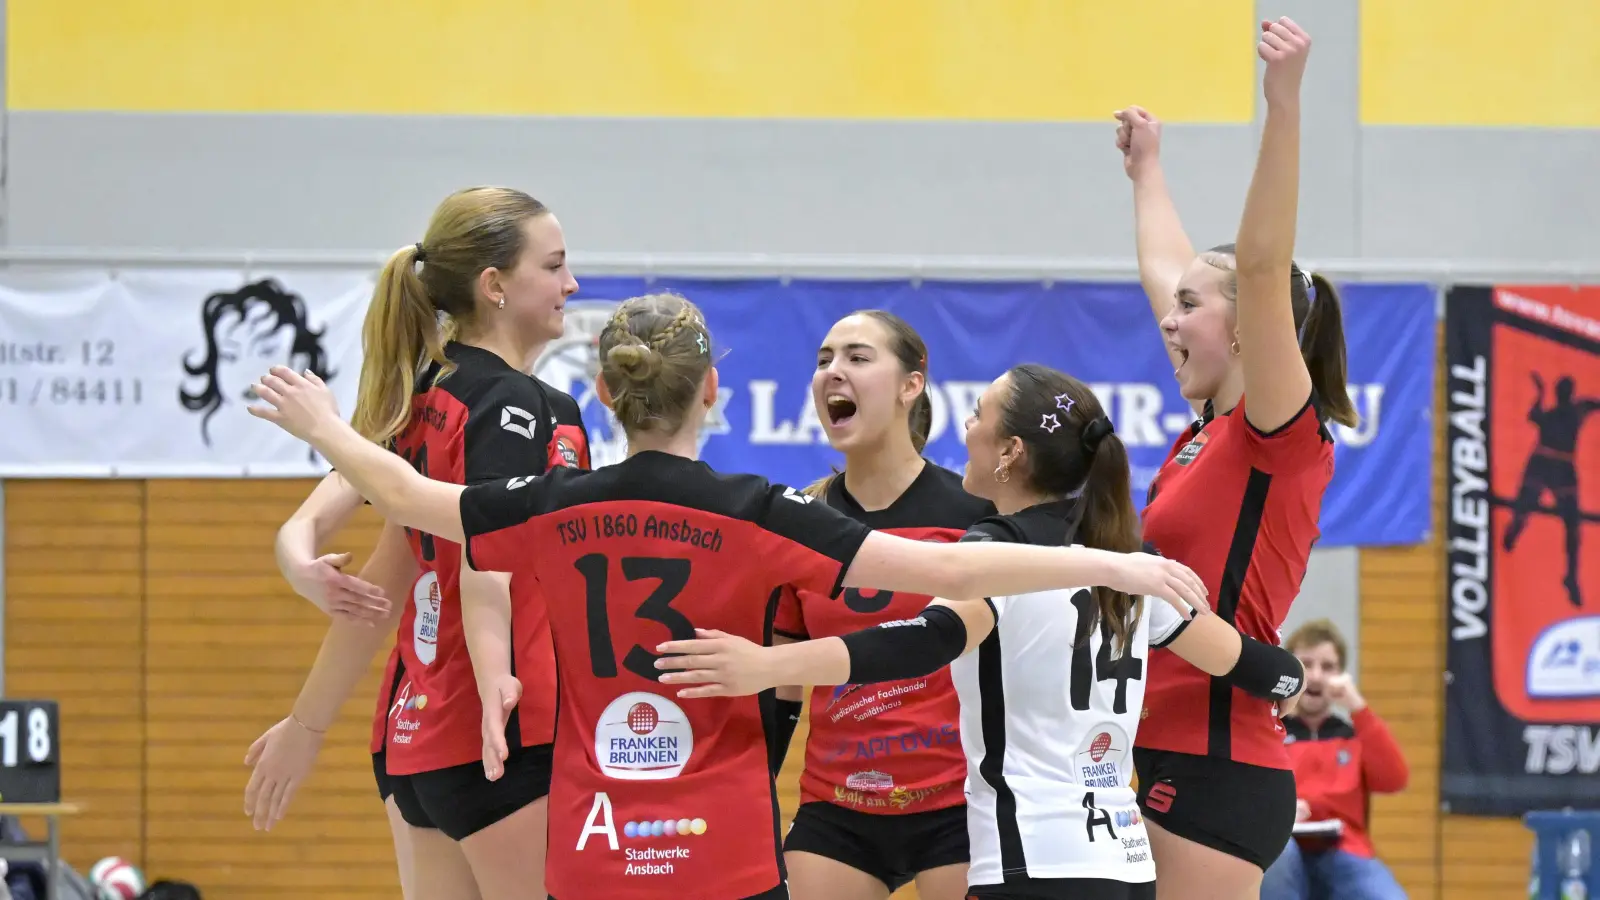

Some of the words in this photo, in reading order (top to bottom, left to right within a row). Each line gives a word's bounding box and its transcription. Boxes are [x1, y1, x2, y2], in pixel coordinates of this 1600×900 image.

[82, 338, 115, 366] 12
[50, 377, 142, 404] 84411
[1451, 355, 1489, 641] VOLLEYBALL
[557, 518, 587, 545] TSV
[594, 514, 638, 538] 1860
[644, 515, 723, 552] Ansbach
[574, 553, 697, 682] 13
[1070, 588, 1143, 715] 14
[830, 695, 876, 723] Medizinischer
[877, 680, 927, 700] Fachhandel
[853, 700, 902, 722] Sanitätshaus
[0, 708, 50, 767] 18
[610, 737, 678, 750] FRANKEN
[1523, 725, 1600, 774] TSV
[609, 751, 678, 764] BRUNNEN
[1082, 762, 1117, 778] FRANKEN
[576, 792, 620, 850] A
[625, 846, 690, 860] Stadtwerke
[625, 862, 674, 876] Ansbach
